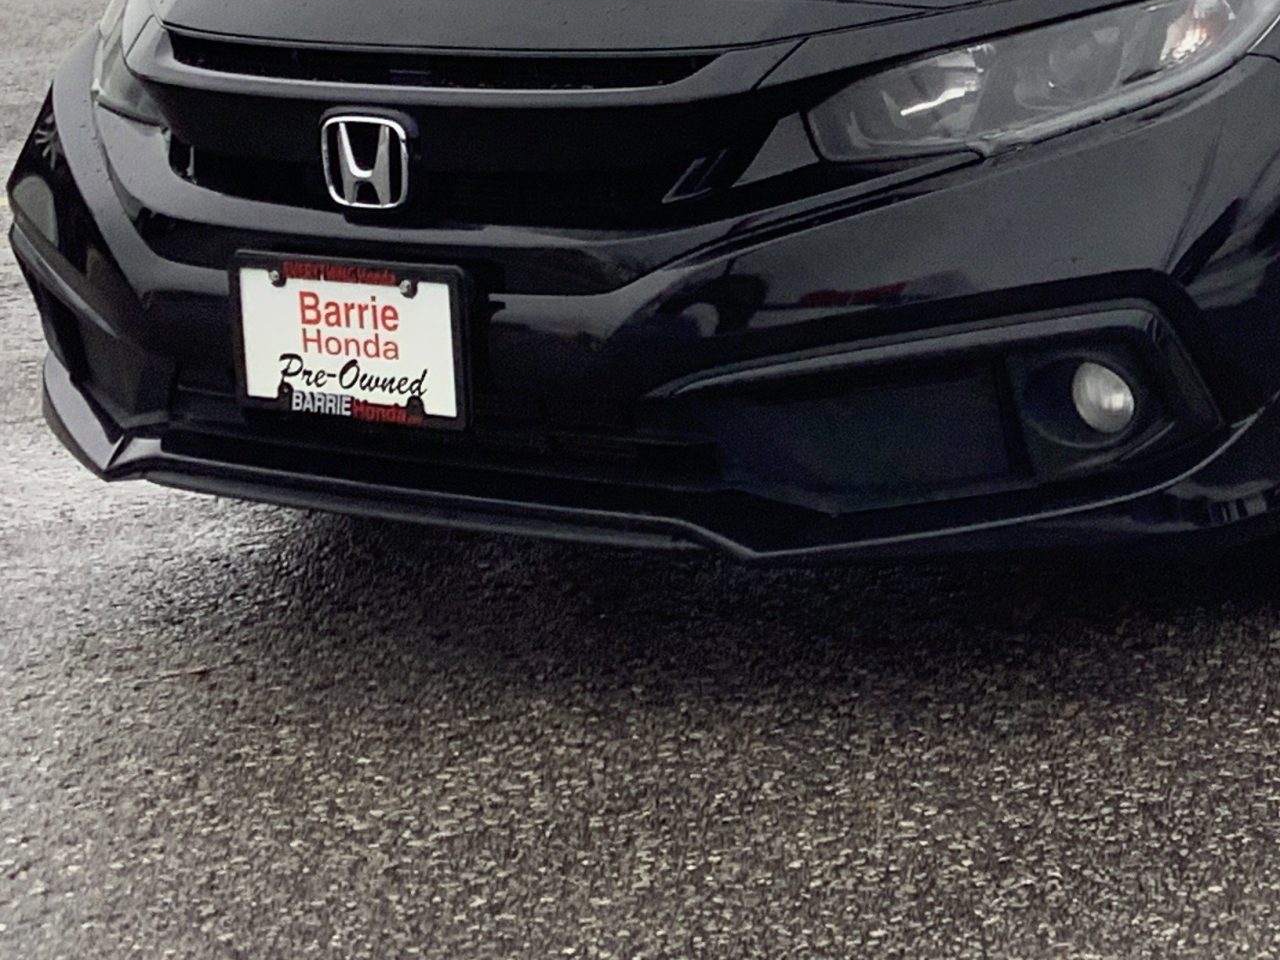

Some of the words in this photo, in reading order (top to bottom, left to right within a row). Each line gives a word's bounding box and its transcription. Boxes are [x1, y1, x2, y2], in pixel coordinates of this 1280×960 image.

[299, 291, 399, 331] Barrie
[302, 328, 399, 360] Honda
[278, 353, 428, 397] Pre-Owned
